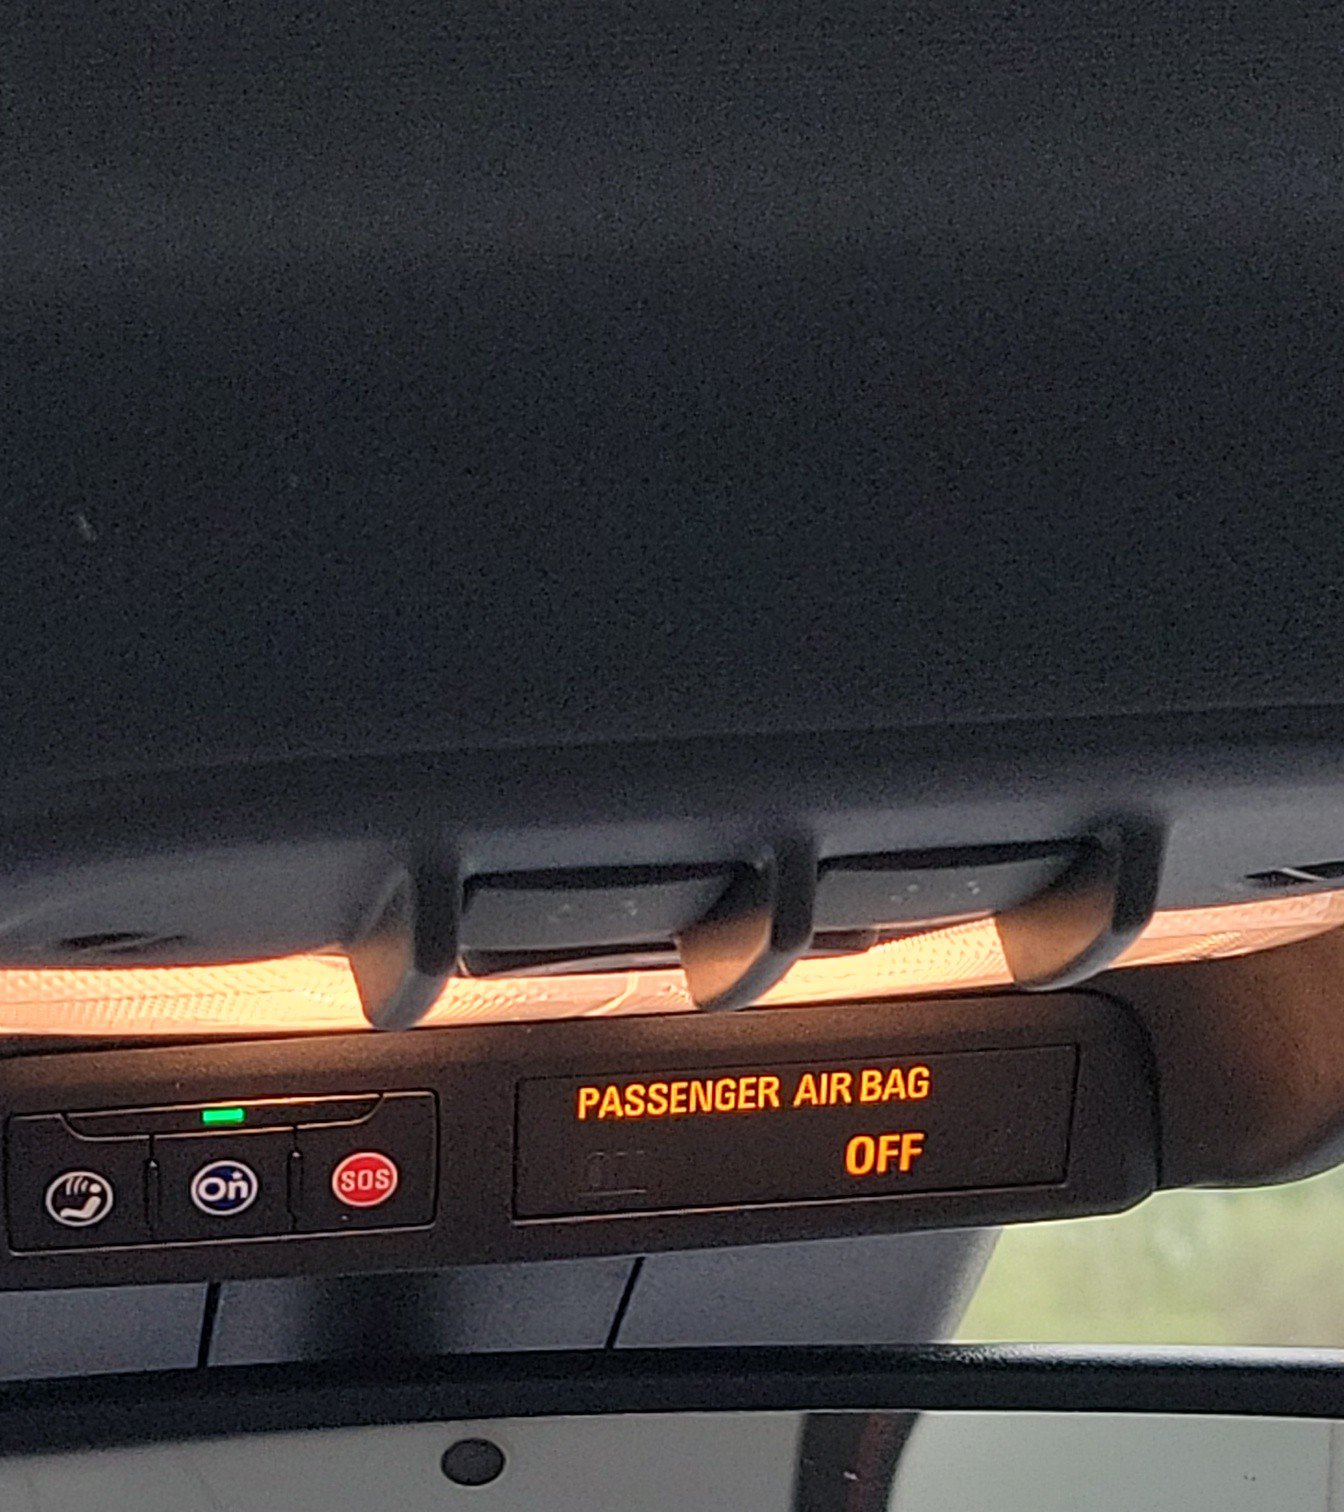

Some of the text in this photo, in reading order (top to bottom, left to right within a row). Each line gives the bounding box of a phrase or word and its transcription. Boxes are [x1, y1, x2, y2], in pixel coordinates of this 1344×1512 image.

[576, 1065, 931, 1121] PASSENGER AIR BAG
[844, 1131, 926, 1177] OFF
[198, 1172, 250, 1201] On
[340, 1168, 391, 1192] SOS
